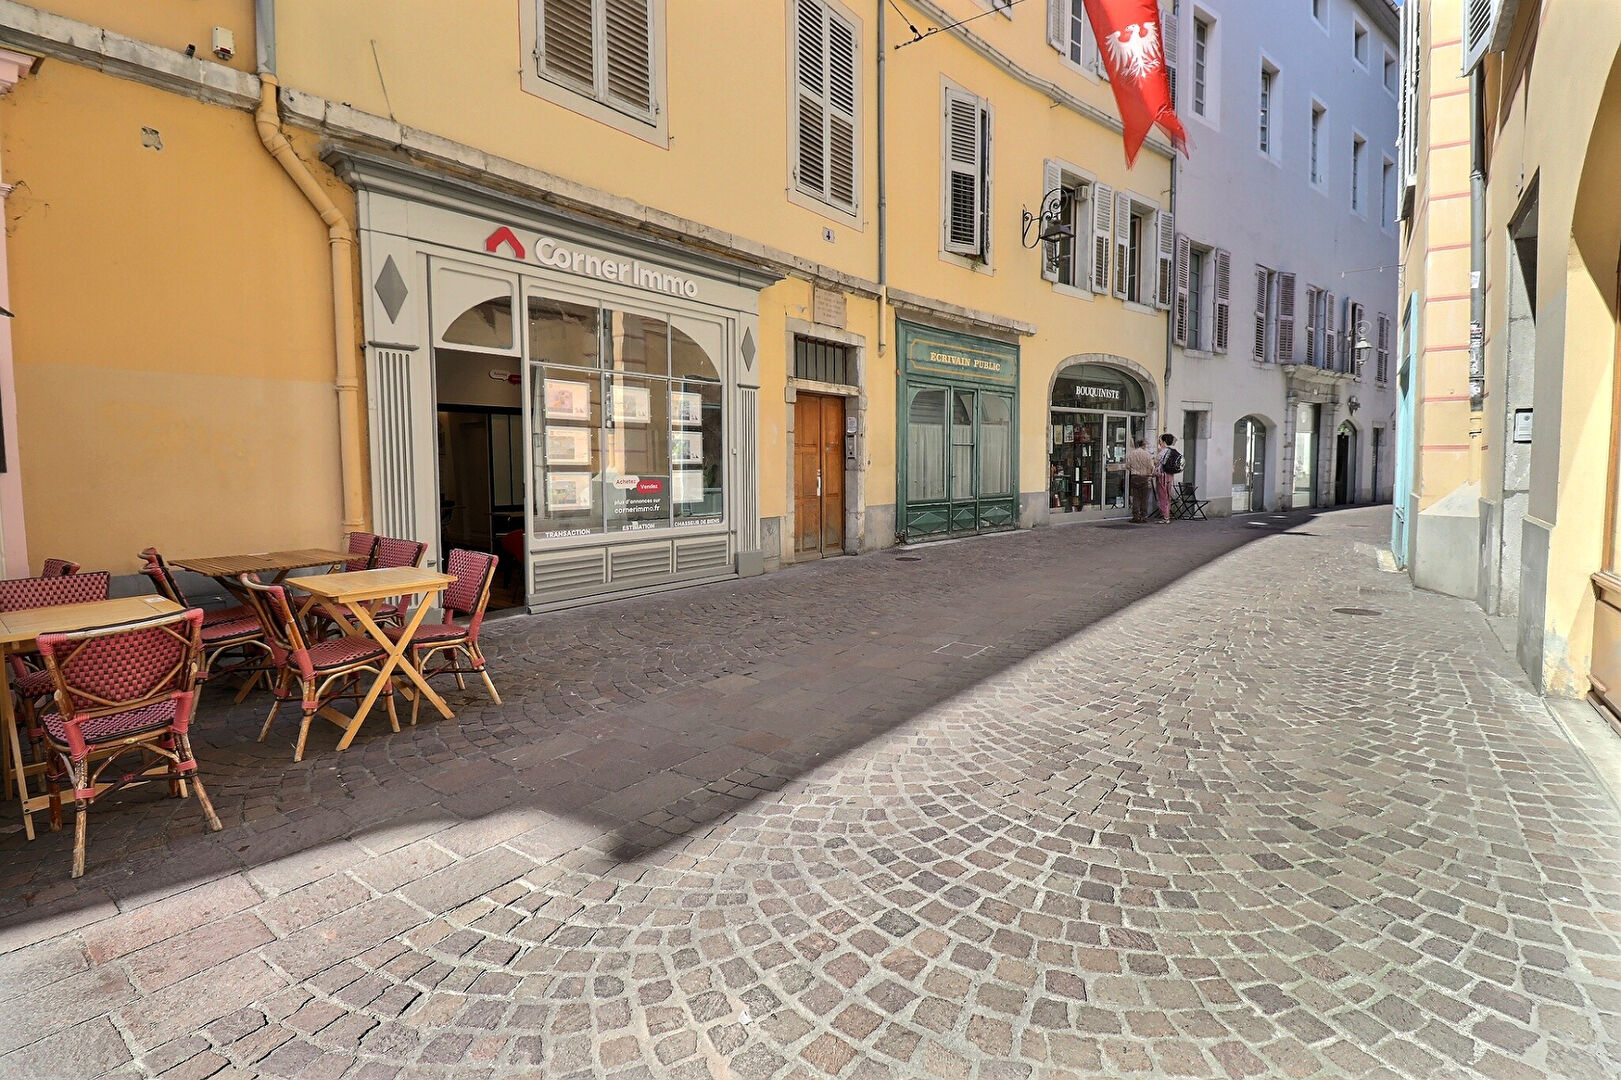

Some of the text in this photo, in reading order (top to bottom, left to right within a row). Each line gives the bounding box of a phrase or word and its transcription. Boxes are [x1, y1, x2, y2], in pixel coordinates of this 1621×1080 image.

[535, 237, 698, 298] Corner Immo
[974, 360, 1001, 371] PUBLIC
[1076, 386, 1120, 399] BOUQUINISTE
[614, 504, 661, 514] cornerimmo.fr
[545, 529, 591, 538] TRANSACTION
